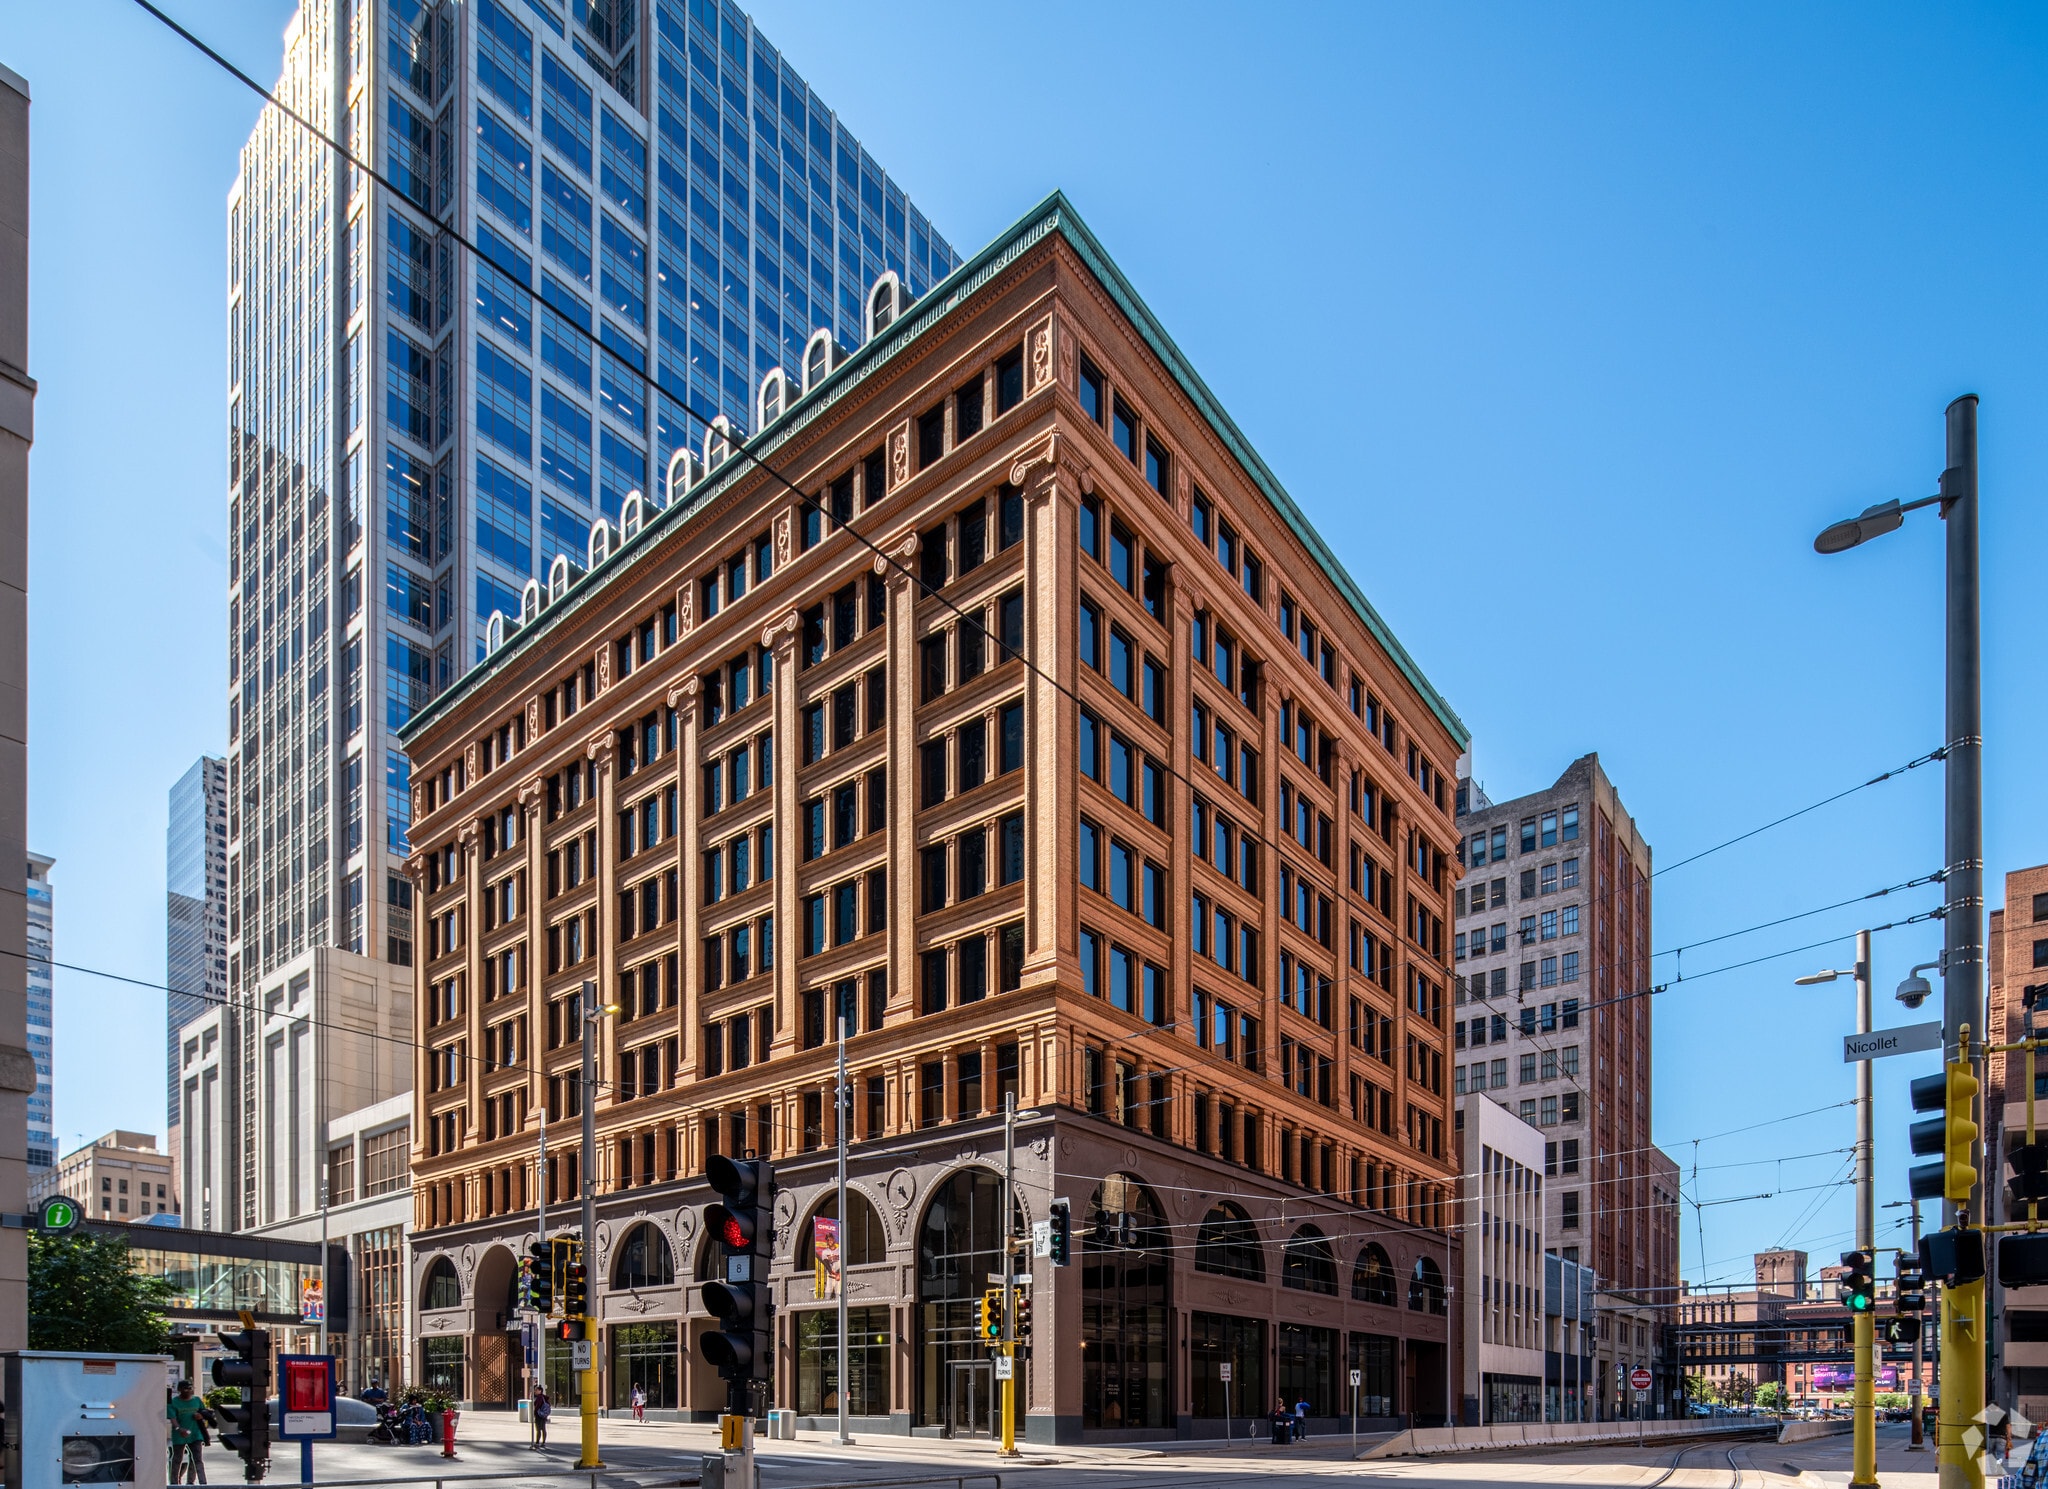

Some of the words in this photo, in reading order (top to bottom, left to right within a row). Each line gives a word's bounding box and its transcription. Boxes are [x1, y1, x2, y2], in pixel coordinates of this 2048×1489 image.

[1846, 1036, 1898, 1055] Nicollet
[736, 1263, 742, 1274] 8
[577, 1344, 587, 1354] NO
[574, 1357, 590, 1365] TURNS
[1000, 1359, 1009, 1367] NO
